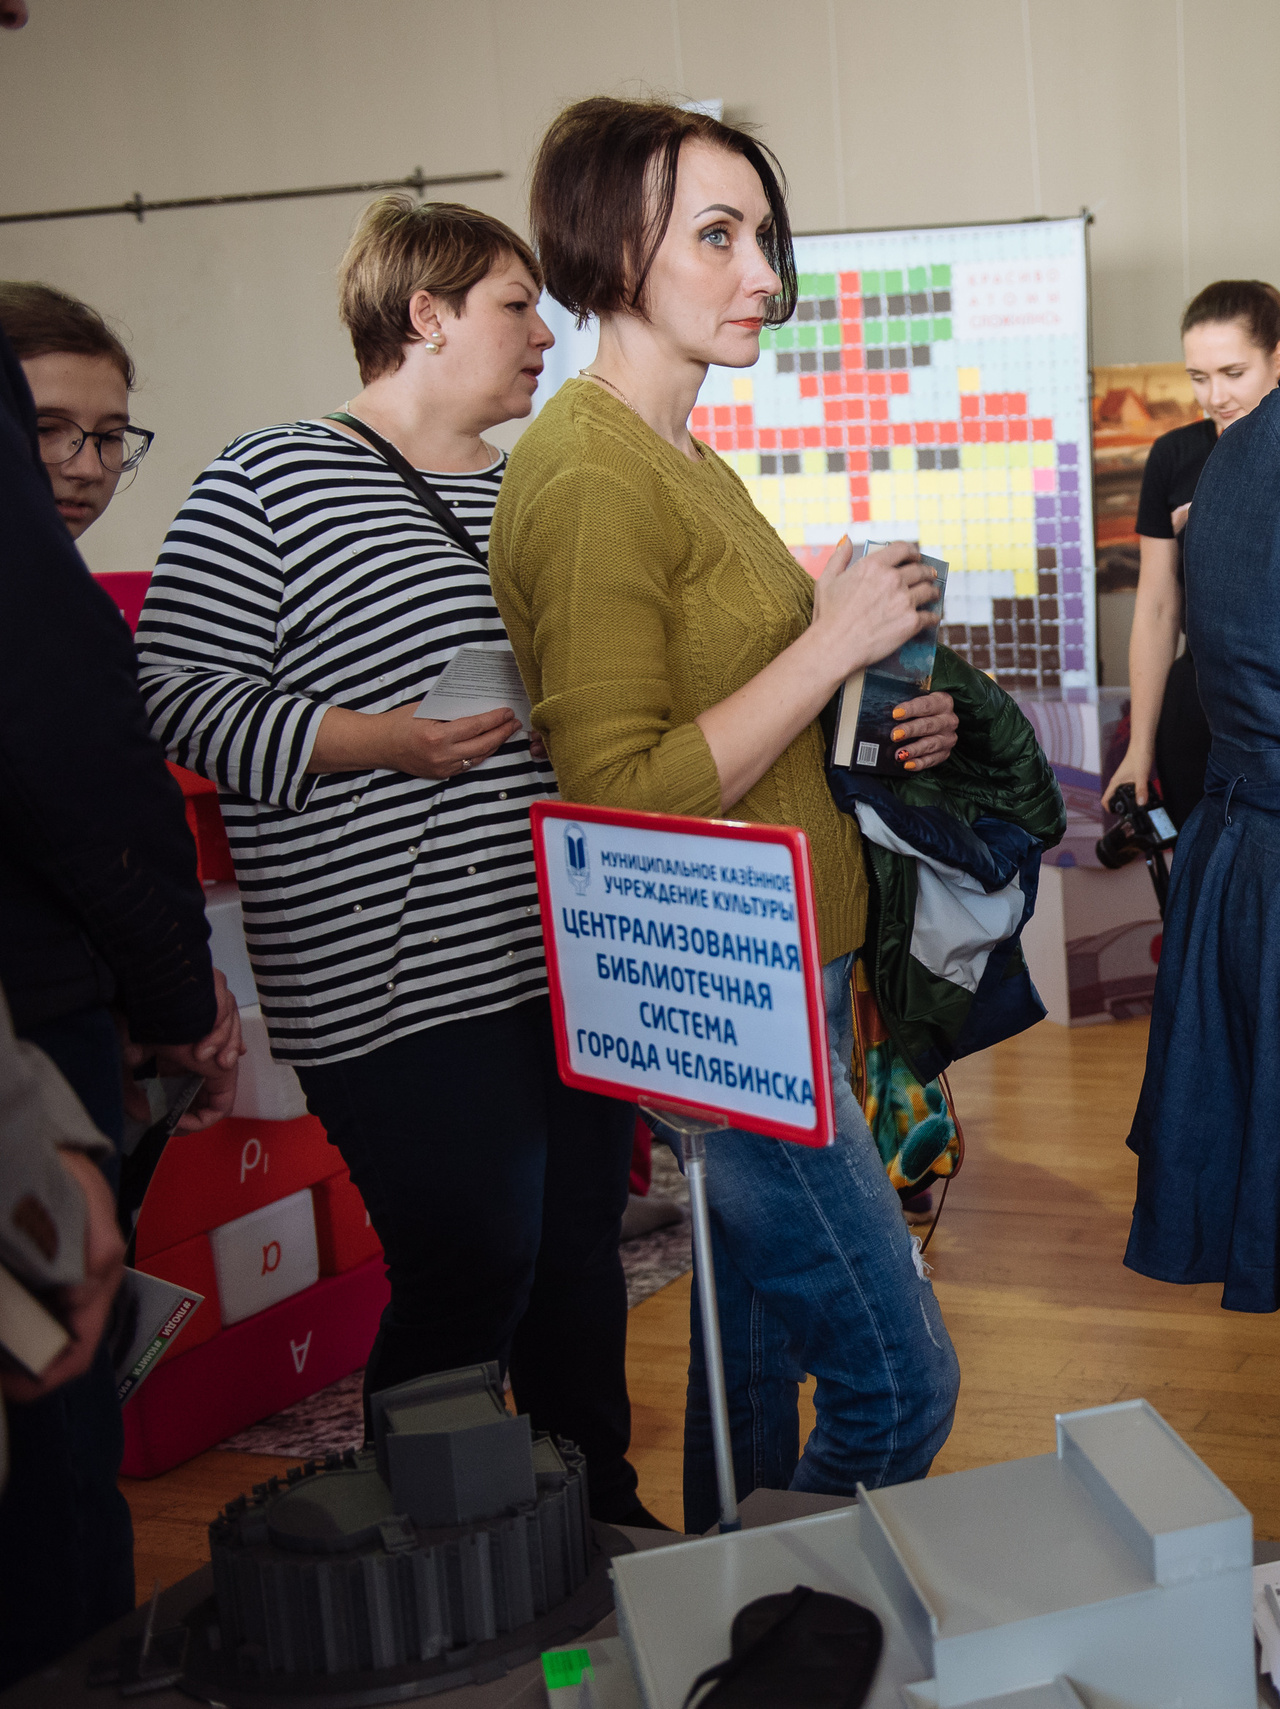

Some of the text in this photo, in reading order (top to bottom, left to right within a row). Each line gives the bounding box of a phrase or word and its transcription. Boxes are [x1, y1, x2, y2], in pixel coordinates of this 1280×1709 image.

[600, 850, 792, 893] МУНИЦИПАЛЬНОЕ КАЗЁННОЕ
[603, 875, 795, 922] УЧРЕЖДЕНИЕ КУЛЬТУРЫ
[562, 907, 802, 972] ЦЕНТРАЛИЗОВАННАЯ
[596, 953, 774, 1011] БИБЛИОТЕЧНАЯ
[639, 1001, 739, 1047] СИСТЕМА
[577, 1029, 816, 1107] ГОРОДА ЧЕЛЯБИНСКА
[161, 1299, 192, 1338] #ЛЮДИ
[132, 1339, 163, 1377] #КНИГИ
